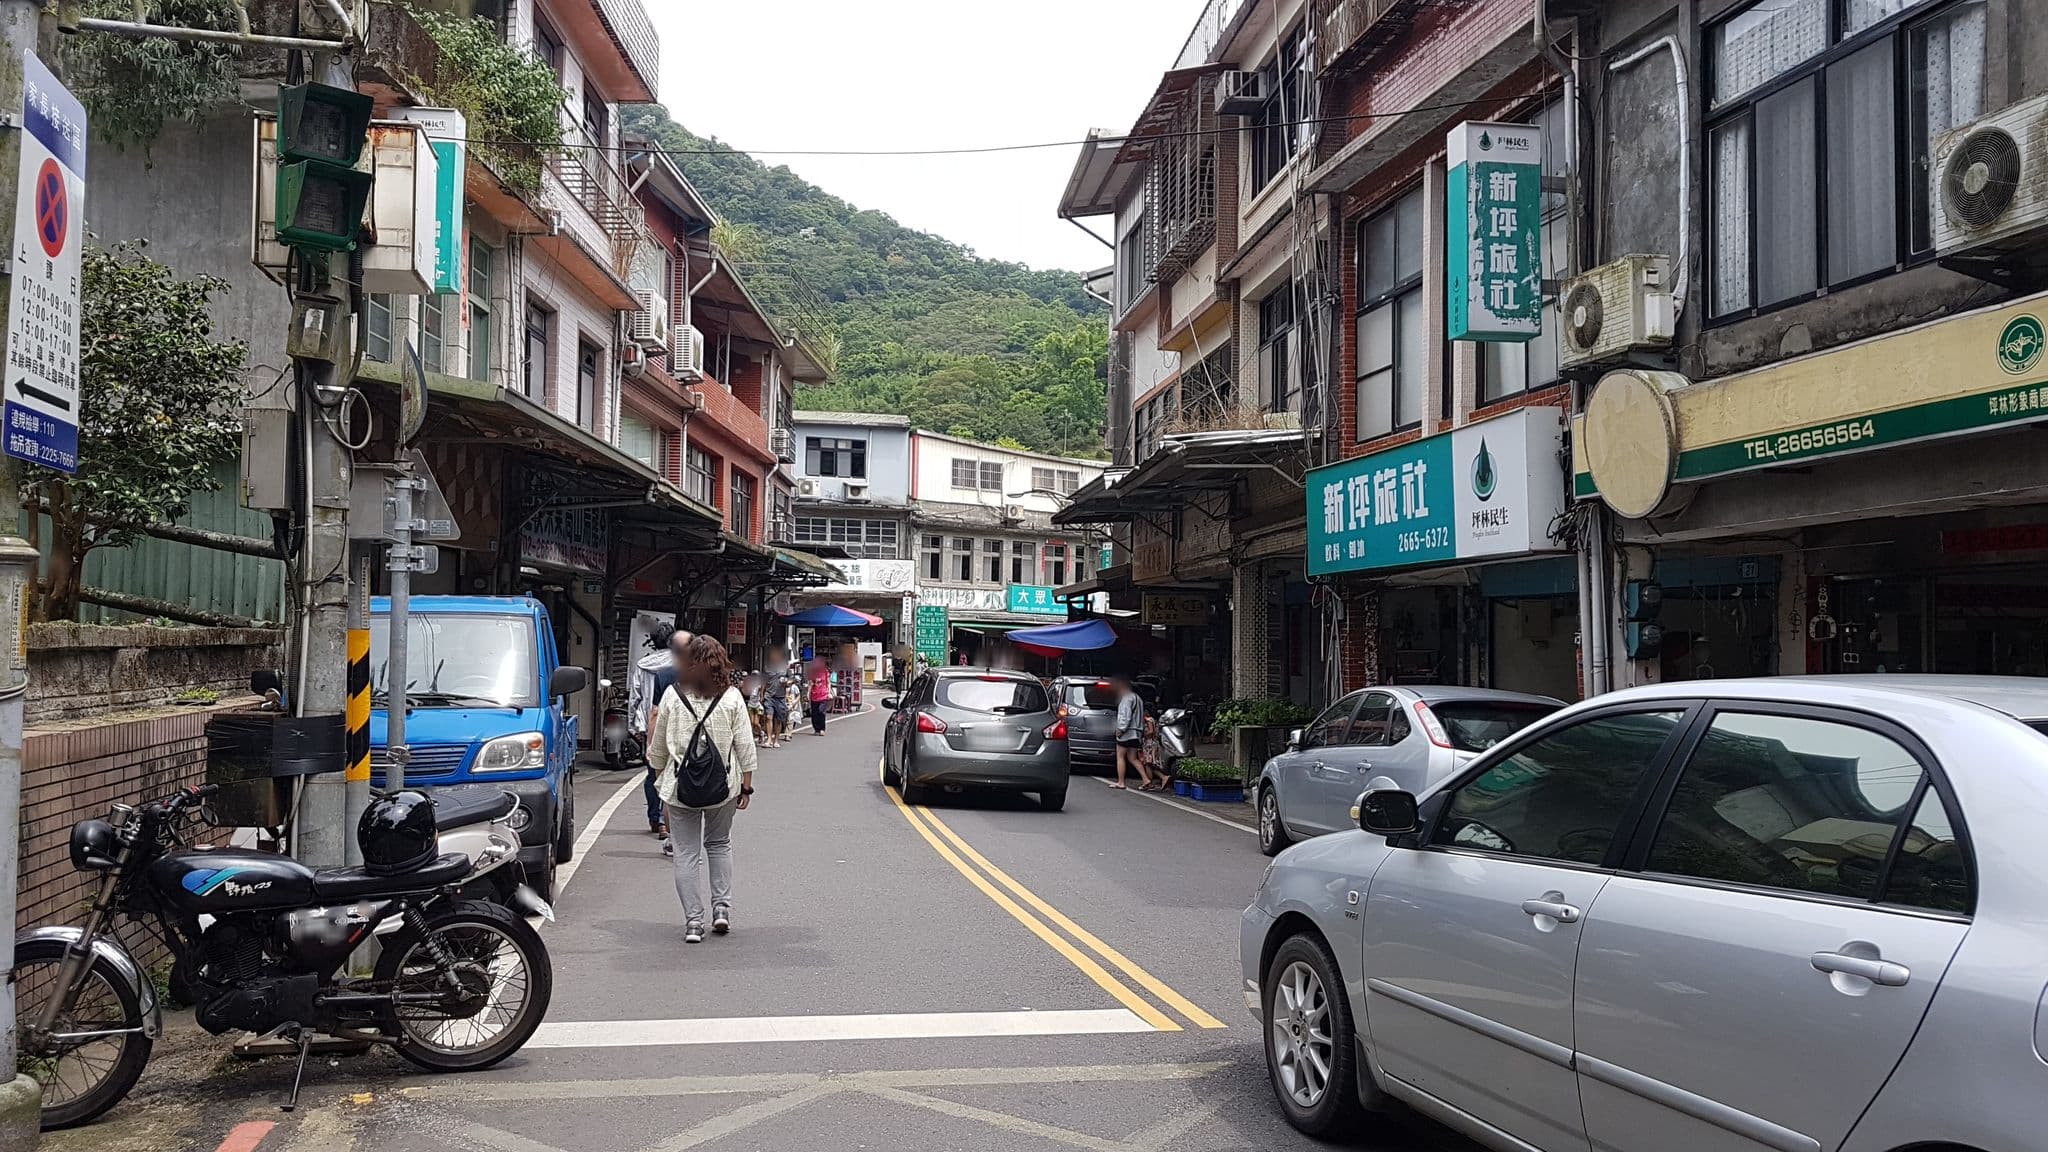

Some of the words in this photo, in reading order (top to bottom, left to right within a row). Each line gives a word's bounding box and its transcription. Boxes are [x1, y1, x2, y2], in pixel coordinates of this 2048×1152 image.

[28, 80, 81, 151] 家長接送區
[1489, 171, 1519, 310] 新坪旅社
[21, 296, 72, 337] 12:00-13:00
[22, 275, 72, 318] 07:00-09:00
[12, 331, 76, 375] 可以臨時停車
[20, 317, 72, 356] 15:00-17:00
[1989, 386, 2048, 416] 坪林形象商圈
[1744, 419, 1875, 459] TEL:26656564
[1323, 459, 1429, 534] 新坪旅社
[1471, 505, 1510, 529] 坪林民生
[1398, 527, 1449, 553] 2665-6372
